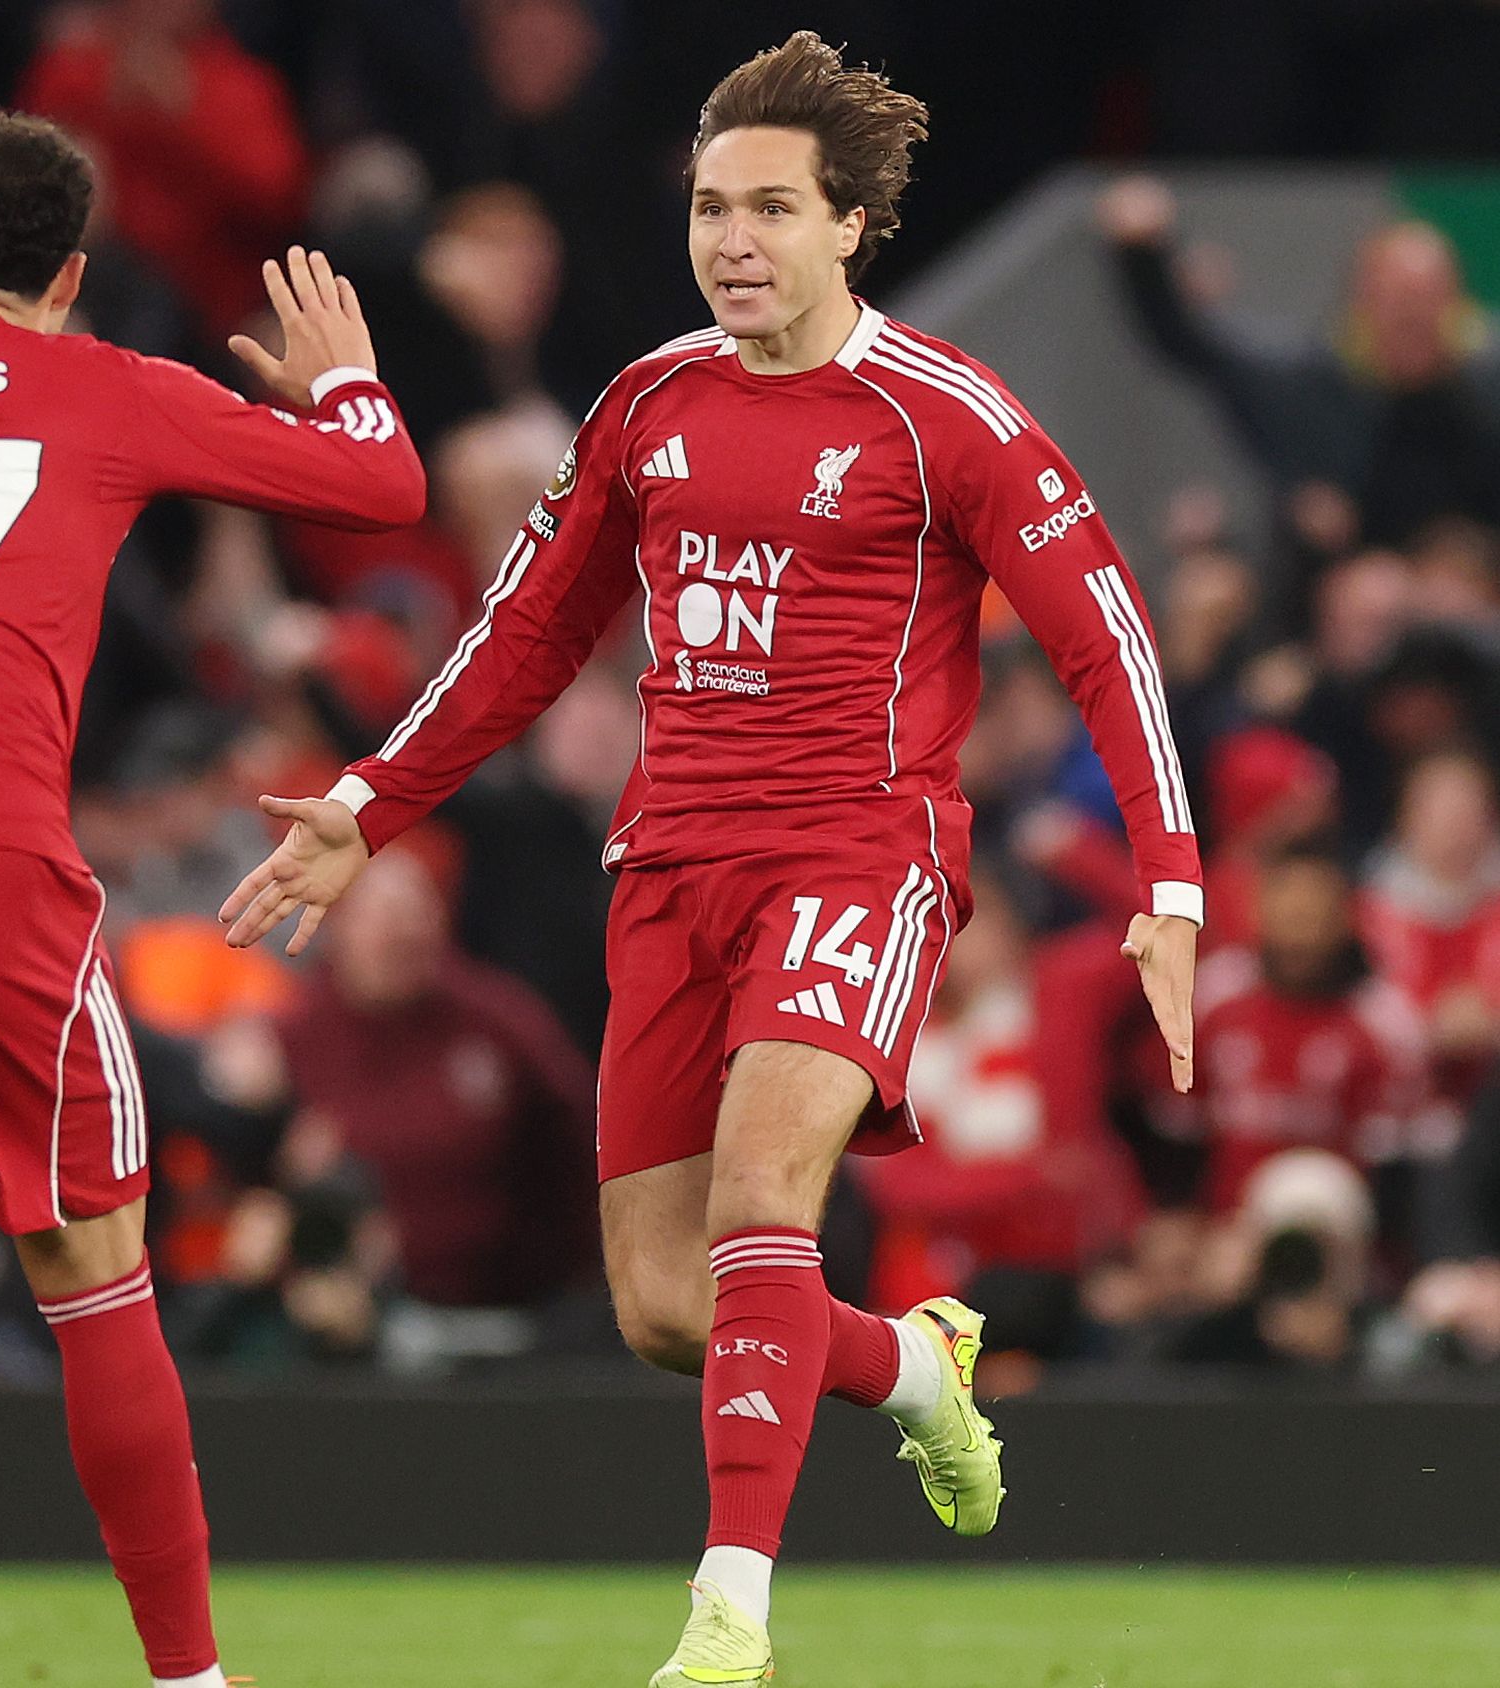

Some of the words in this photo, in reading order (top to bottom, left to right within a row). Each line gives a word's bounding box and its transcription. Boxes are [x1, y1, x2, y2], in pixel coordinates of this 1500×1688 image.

[1018, 490, 1096, 552] Exped
[677, 530, 794, 589] PLAY
[677, 582, 779, 657] ON
[696, 659, 767, 683] standard
[696, 673, 770, 696] chartered
[781, 896, 877, 989] 14
[714, 1338, 788, 1366] LFC
